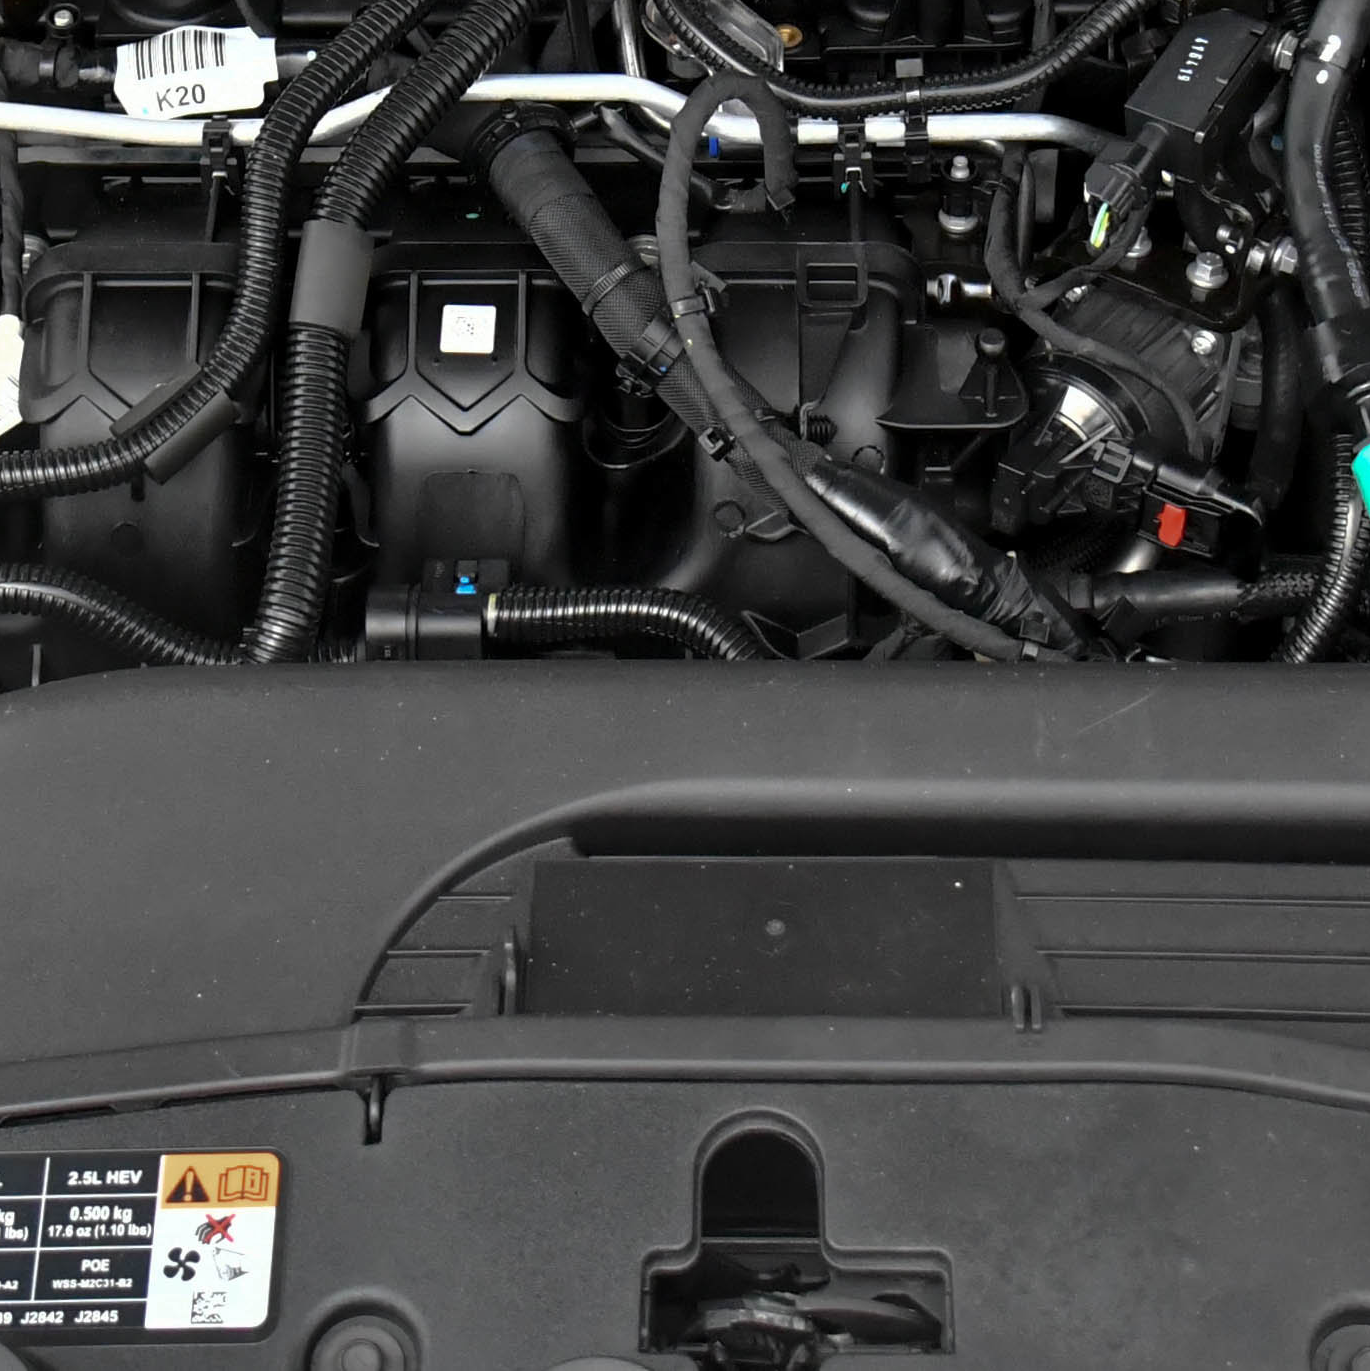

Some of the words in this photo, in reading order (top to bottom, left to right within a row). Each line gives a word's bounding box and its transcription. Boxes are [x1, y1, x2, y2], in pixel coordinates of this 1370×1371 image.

[156, 84, 206, 110] K20
[67, 1171, 102, 1185] 2.5L
[106, 1170, 142, 1184] HEV
[69, 1207, 110, 1221] 0.500
[113, 1206, 132, 1223] kg
[4, 1227, 28, 1241] lbs)
[48, 1225, 73, 1237] 17.6
[76, 1226, 91, 1237] oz
[94, 1224, 125, 1239] (1.10
[127, 1224, 152, 1238] lbs)
[81, 1259, 111, 1272] POE
[20, 1311, 64, 1325] J2842
[75, 1310, 119, 1324] J2845
